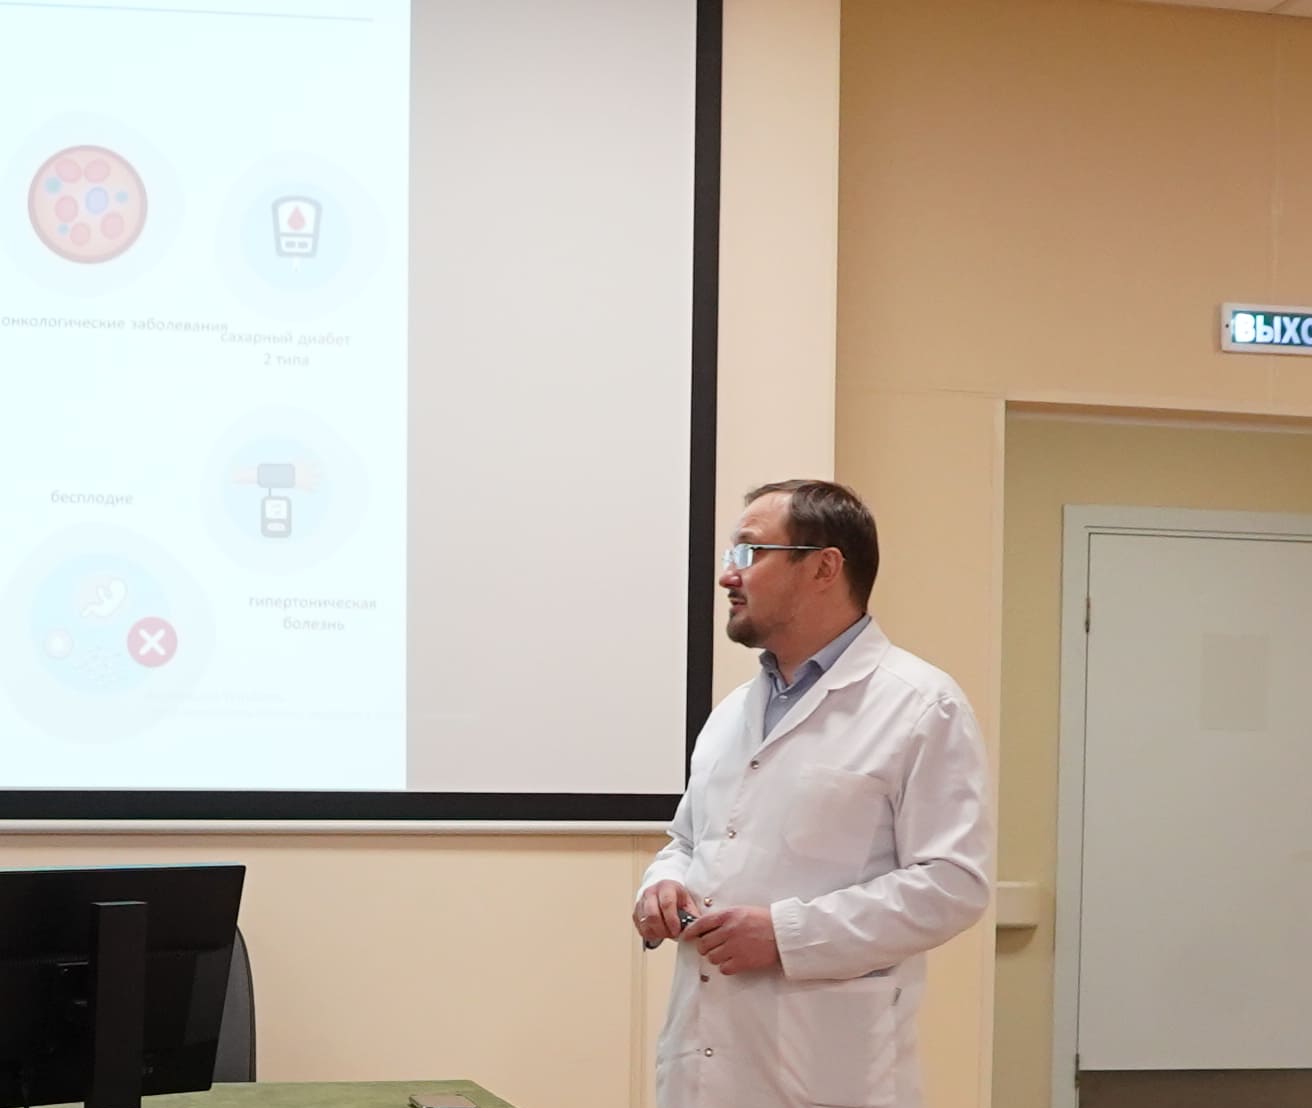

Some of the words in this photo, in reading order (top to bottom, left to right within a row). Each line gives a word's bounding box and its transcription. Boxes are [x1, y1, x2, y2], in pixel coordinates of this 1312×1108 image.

[1, 315, 125, 330] онкологические
[130, 317, 228, 333] заболевания
[220, 330, 293, 346] сахарный
[263, 353, 272, 366] 2
[276, 355, 310, 366] типа
[50, 489, 134, 505] бесплодие
[248, 596, 377, 609] гипертоническая
[282, 616, 345, 630] болезнь
